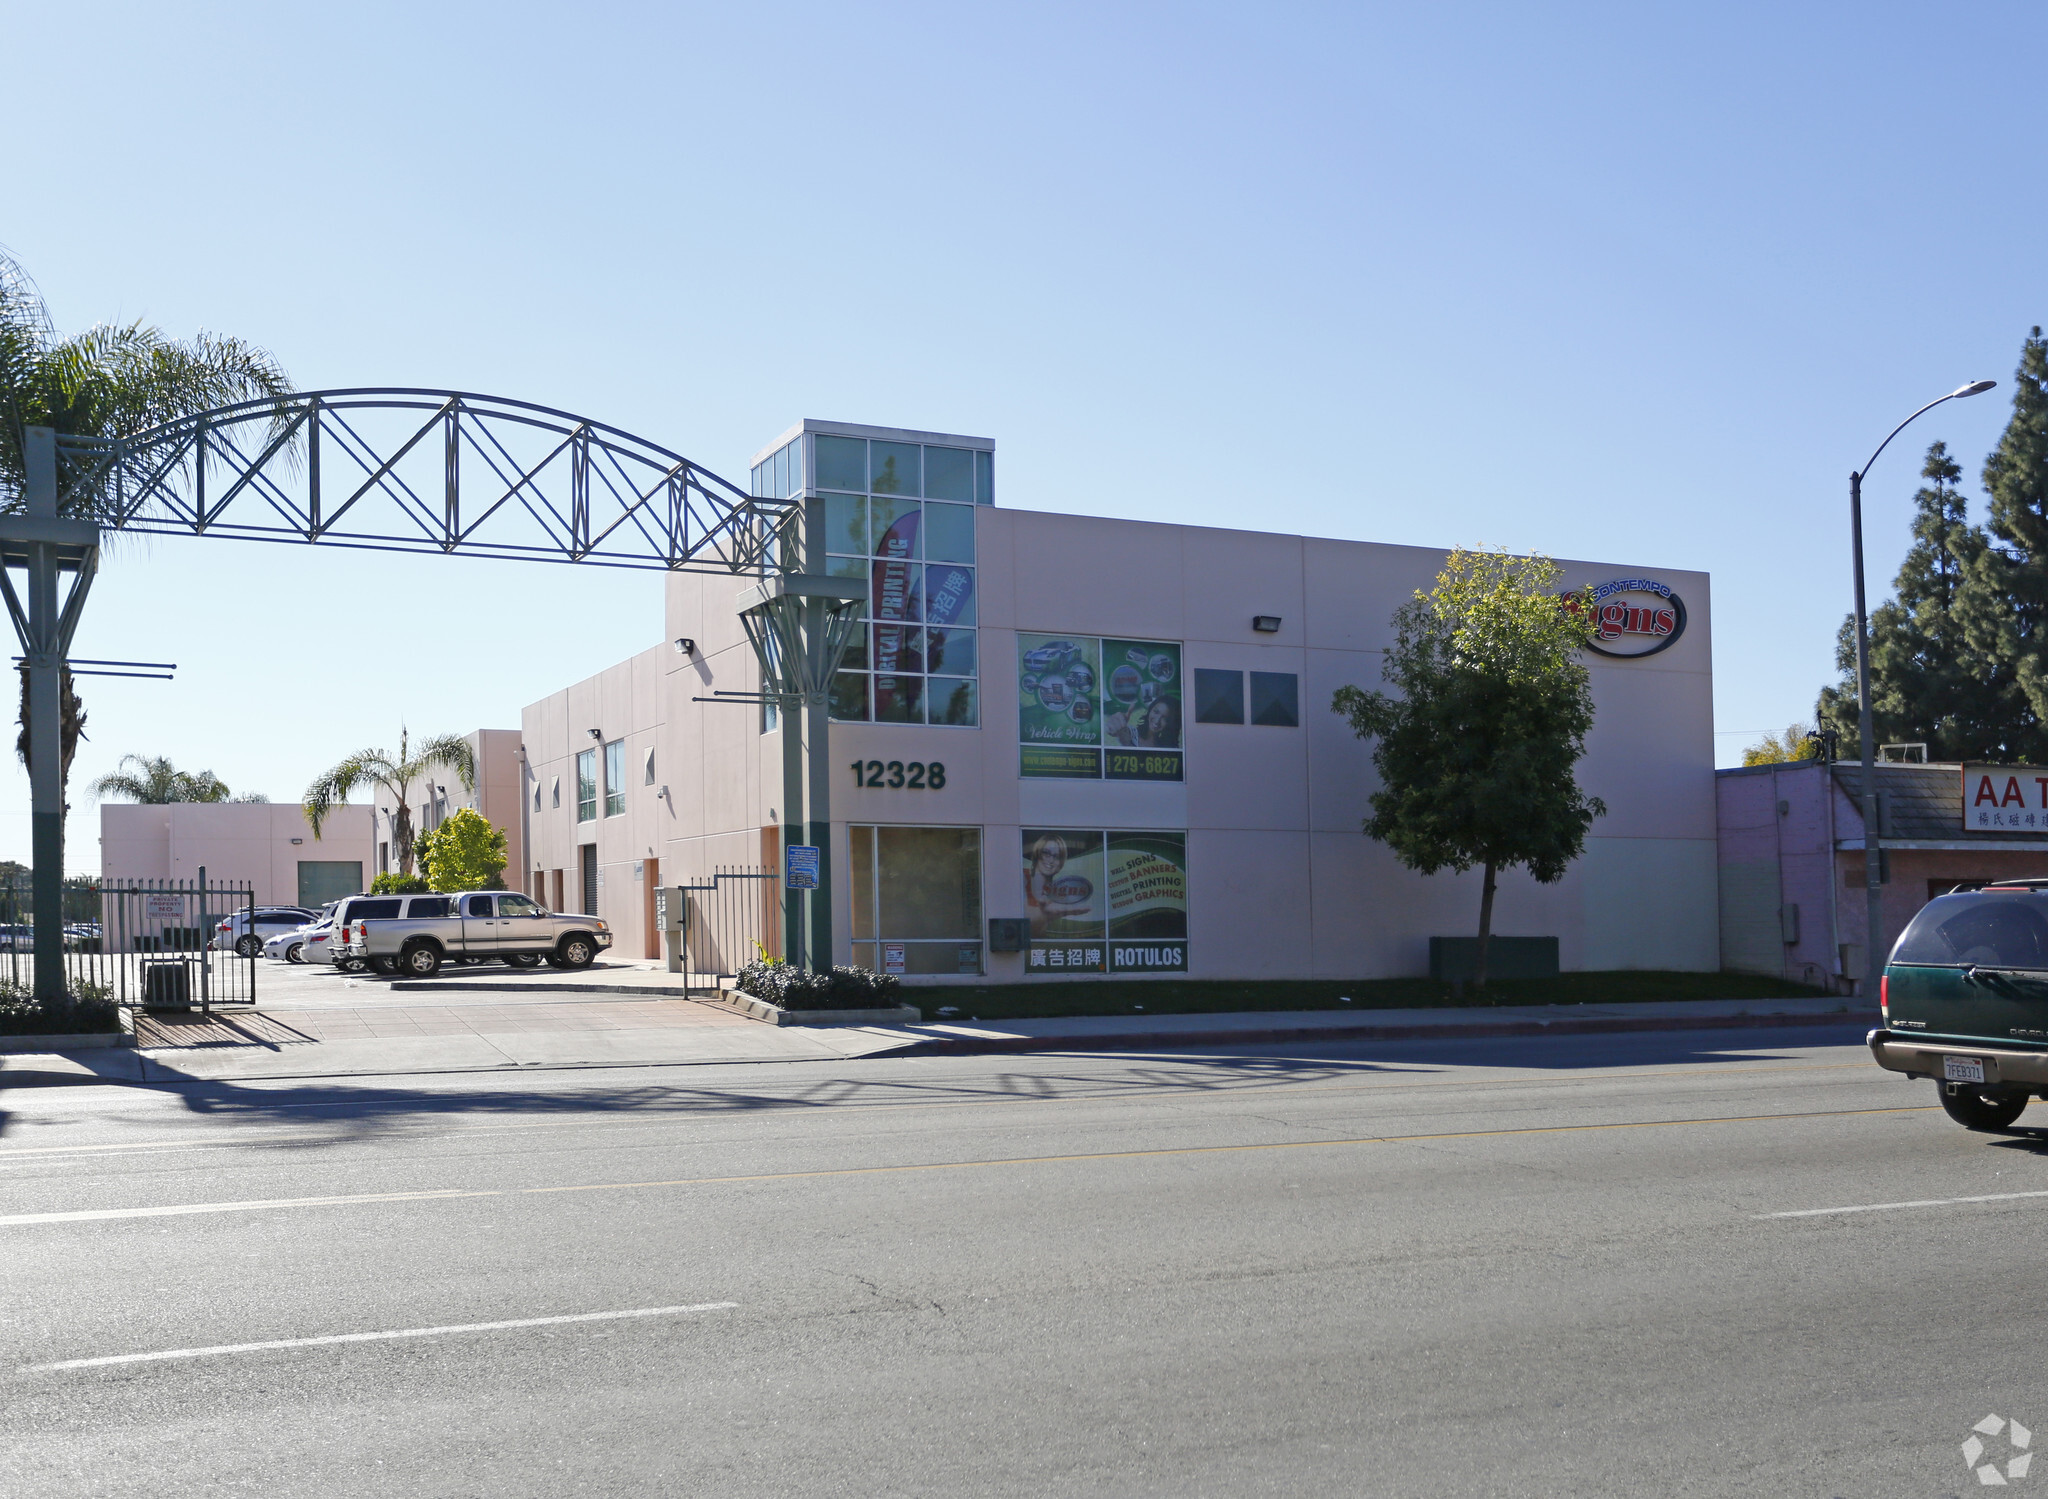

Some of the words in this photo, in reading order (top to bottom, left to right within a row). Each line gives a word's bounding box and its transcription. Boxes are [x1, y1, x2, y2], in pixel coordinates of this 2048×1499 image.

[881, 538, 909, 618] PRINTING
[1593, 579, 1672, 604] CONTEMPO
[849, 759, 947, 790] 12328
[1974, 775, 2026, 809] AA
[1126, 854, 1157, 870] SIGNS
[1129, 864, 1178, 881] BANNERS
[1133, 876, 1182, 892] PRINTING
[1134, 889, 1184, 902] GRAPHICS
[1030, 949, 1101, 967] 廣告招牌
[1114, 948, 1182, 967] ROTULOS
[2009, 1028, 2048, 1037] CHEVROL
[1946, 1064, 1982, 1079] 7FEB371
